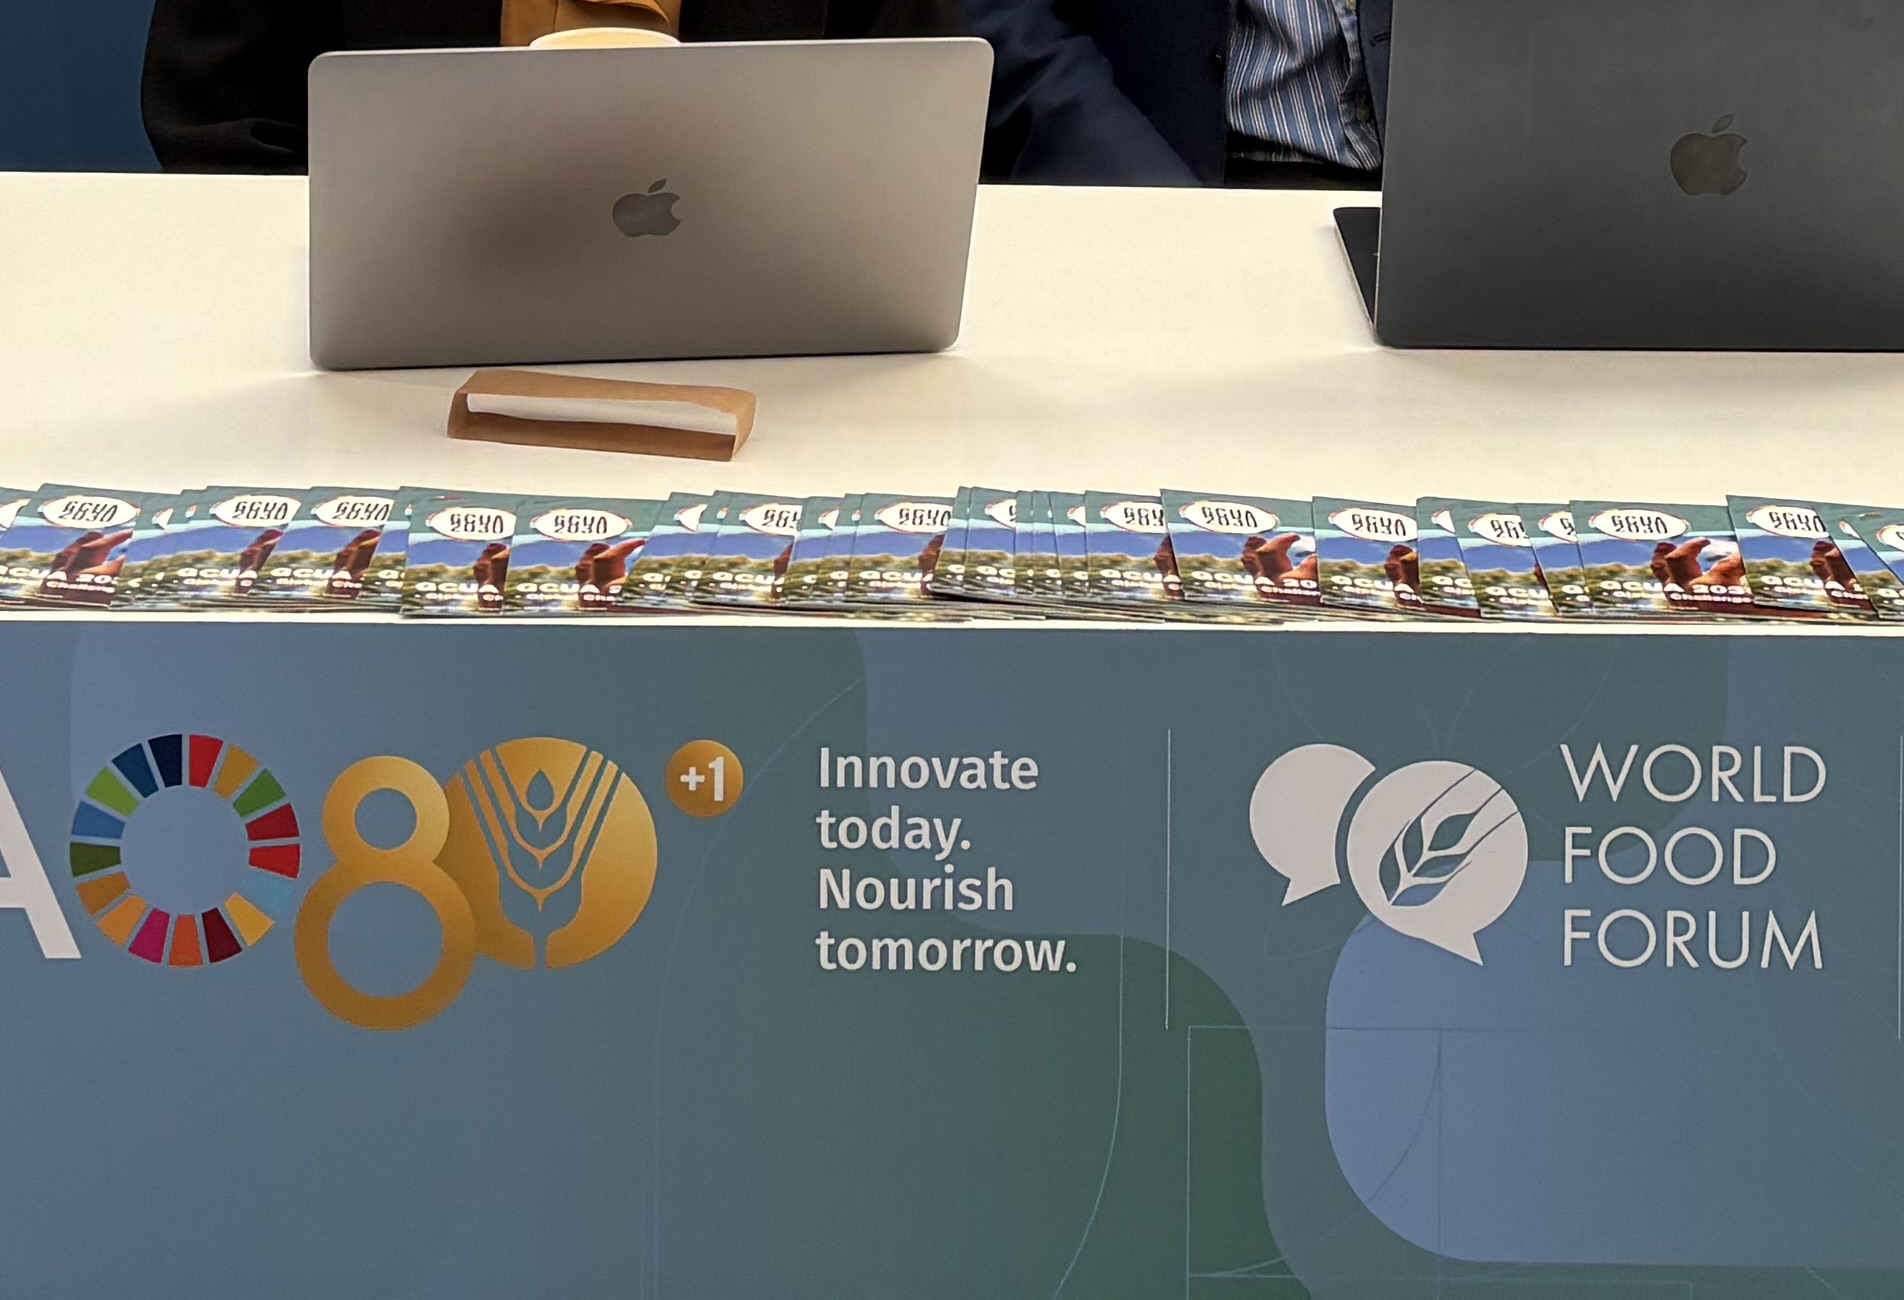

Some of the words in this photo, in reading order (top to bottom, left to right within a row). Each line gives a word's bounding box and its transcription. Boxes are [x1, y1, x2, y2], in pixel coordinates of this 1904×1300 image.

[678, 755, 727, 802] +1
[821, 748, 1038, 789] Innovate
[1560, 743, 1826, 802] WORLD
[816, 805, 970, 860] today.
[1565, 827, 1776, 885] FOOD
[820, 864, 1012, 910] Nourish
[816, 931, 1076, 972] tomorrow.
[1564, 909, 1822, 969] FORUM
